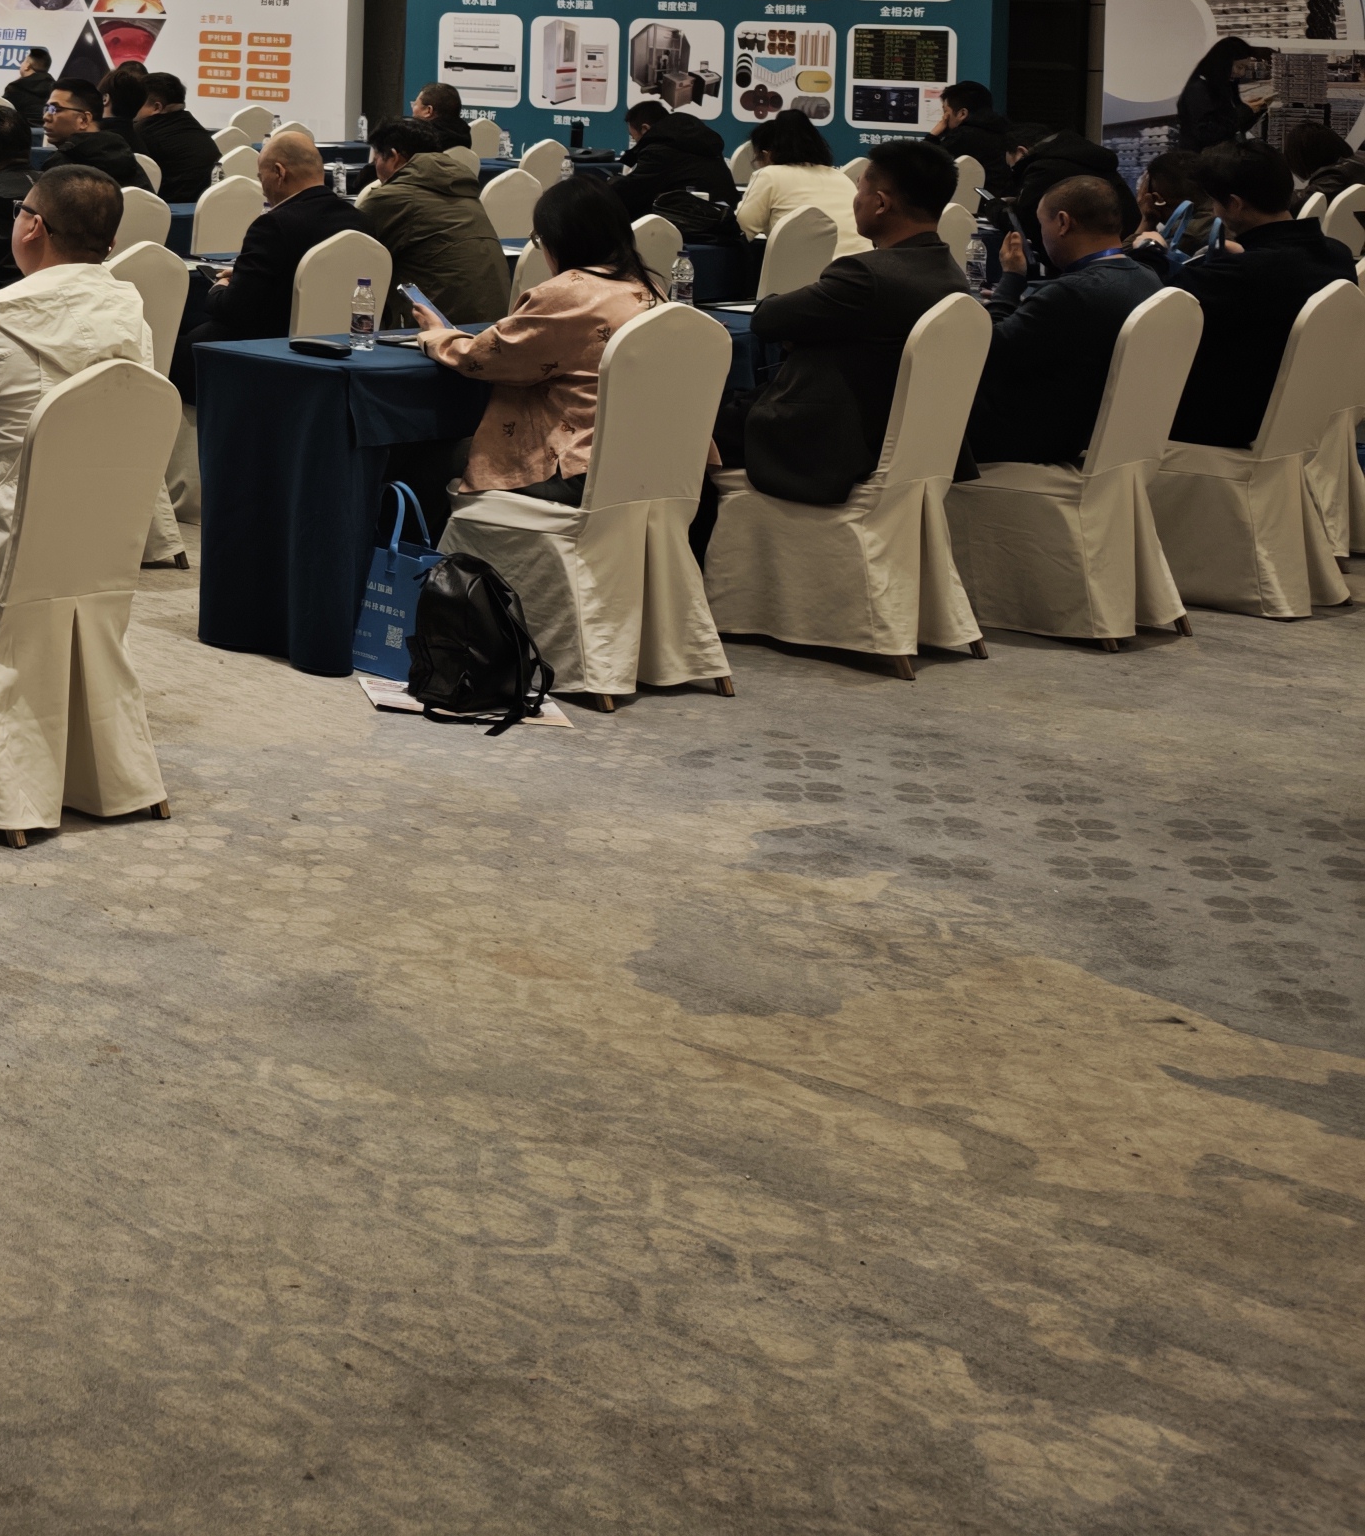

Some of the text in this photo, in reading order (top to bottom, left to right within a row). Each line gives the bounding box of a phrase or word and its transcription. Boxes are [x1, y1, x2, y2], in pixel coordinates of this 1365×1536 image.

[556, 0, 594, 10] 铁水测温
[657, 1, 698, 12] 硬度检测
[764, 3, 807, 16] 金相制样
[879, 6, 926, 18] 金相分析
[199, 14, 233, 25] 主营产品
[459, 109, 497, 121] 光谱分析
[361, 599, 406, 619] 科技有限公司
